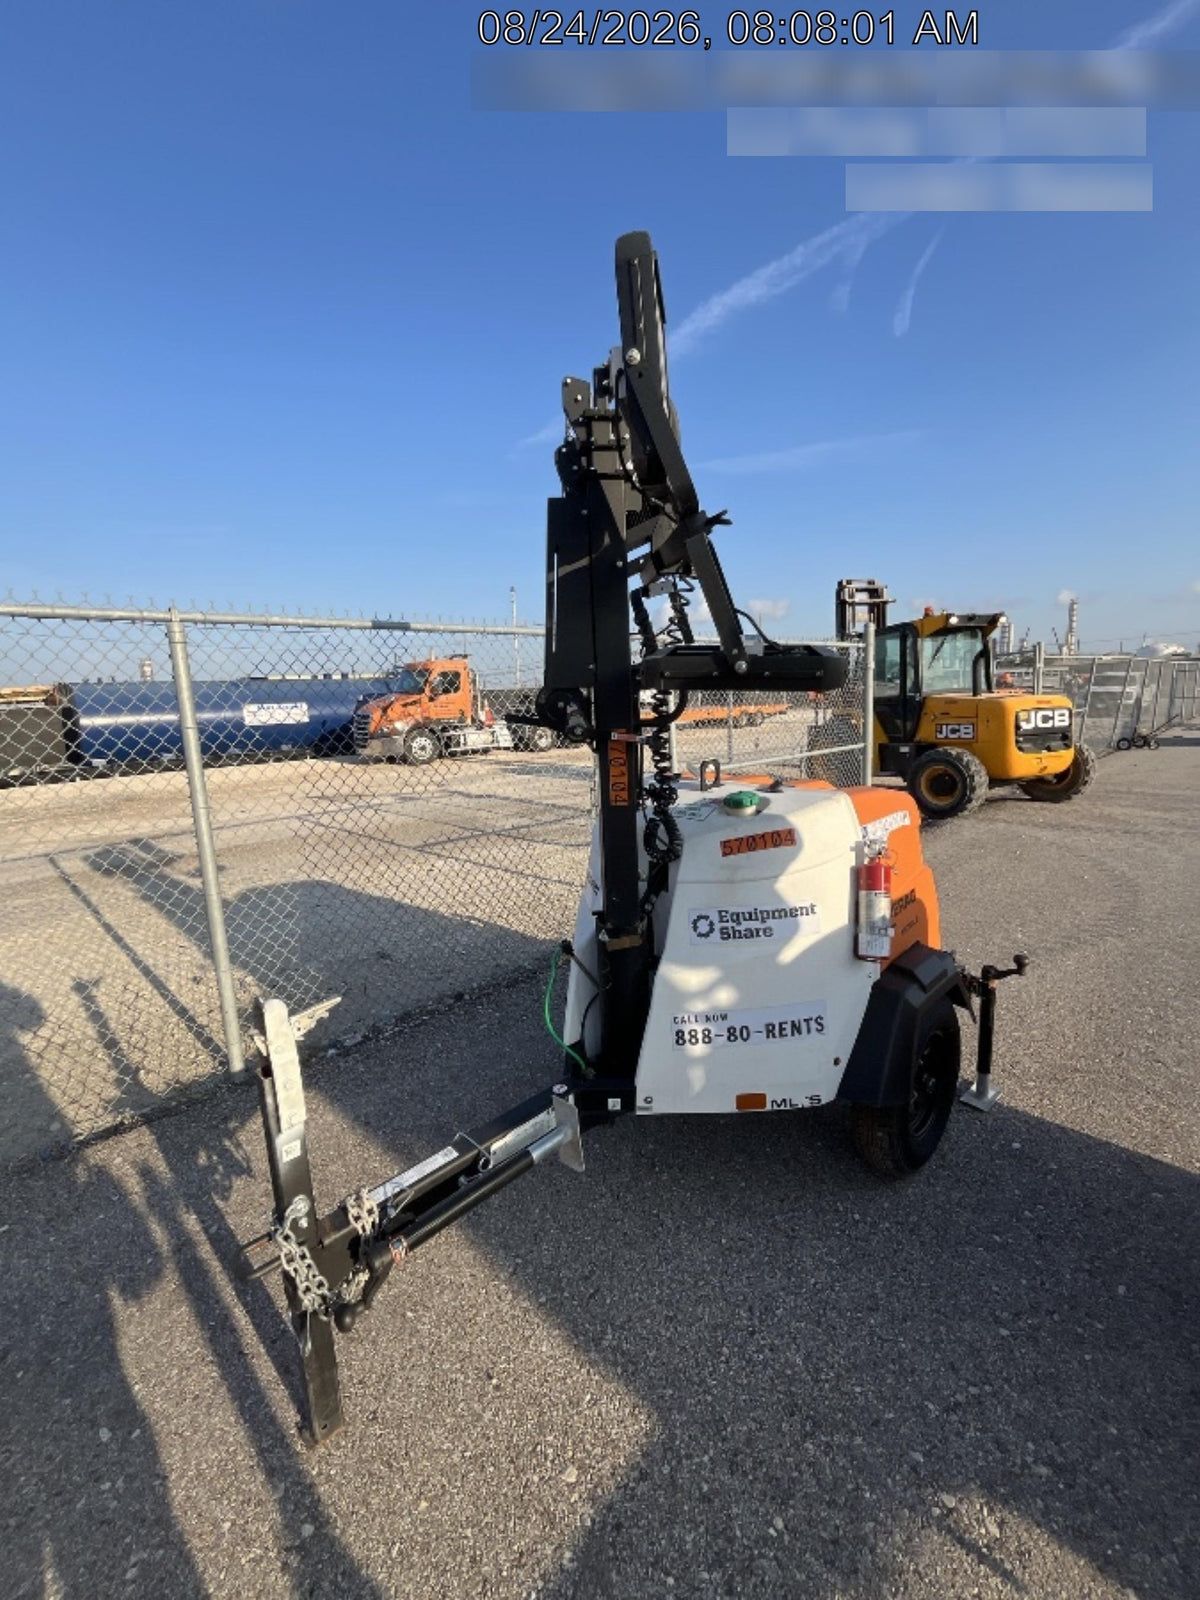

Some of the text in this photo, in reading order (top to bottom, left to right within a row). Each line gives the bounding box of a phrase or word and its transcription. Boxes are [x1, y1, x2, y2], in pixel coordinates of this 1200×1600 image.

[1018, 709, 1070, 729] JCB
[936, 724, 974, 739] JCB
[608, 729, 628, 806] 70104
[720, 828, 797, 857] 570104
[718, 903, 817, 925] Equipment
[719, 926, 774, 941] Share
[673, 1013, 729, 1025] CALL NOW
[674, 1015, 826, 1046] 888-80-RENTS
